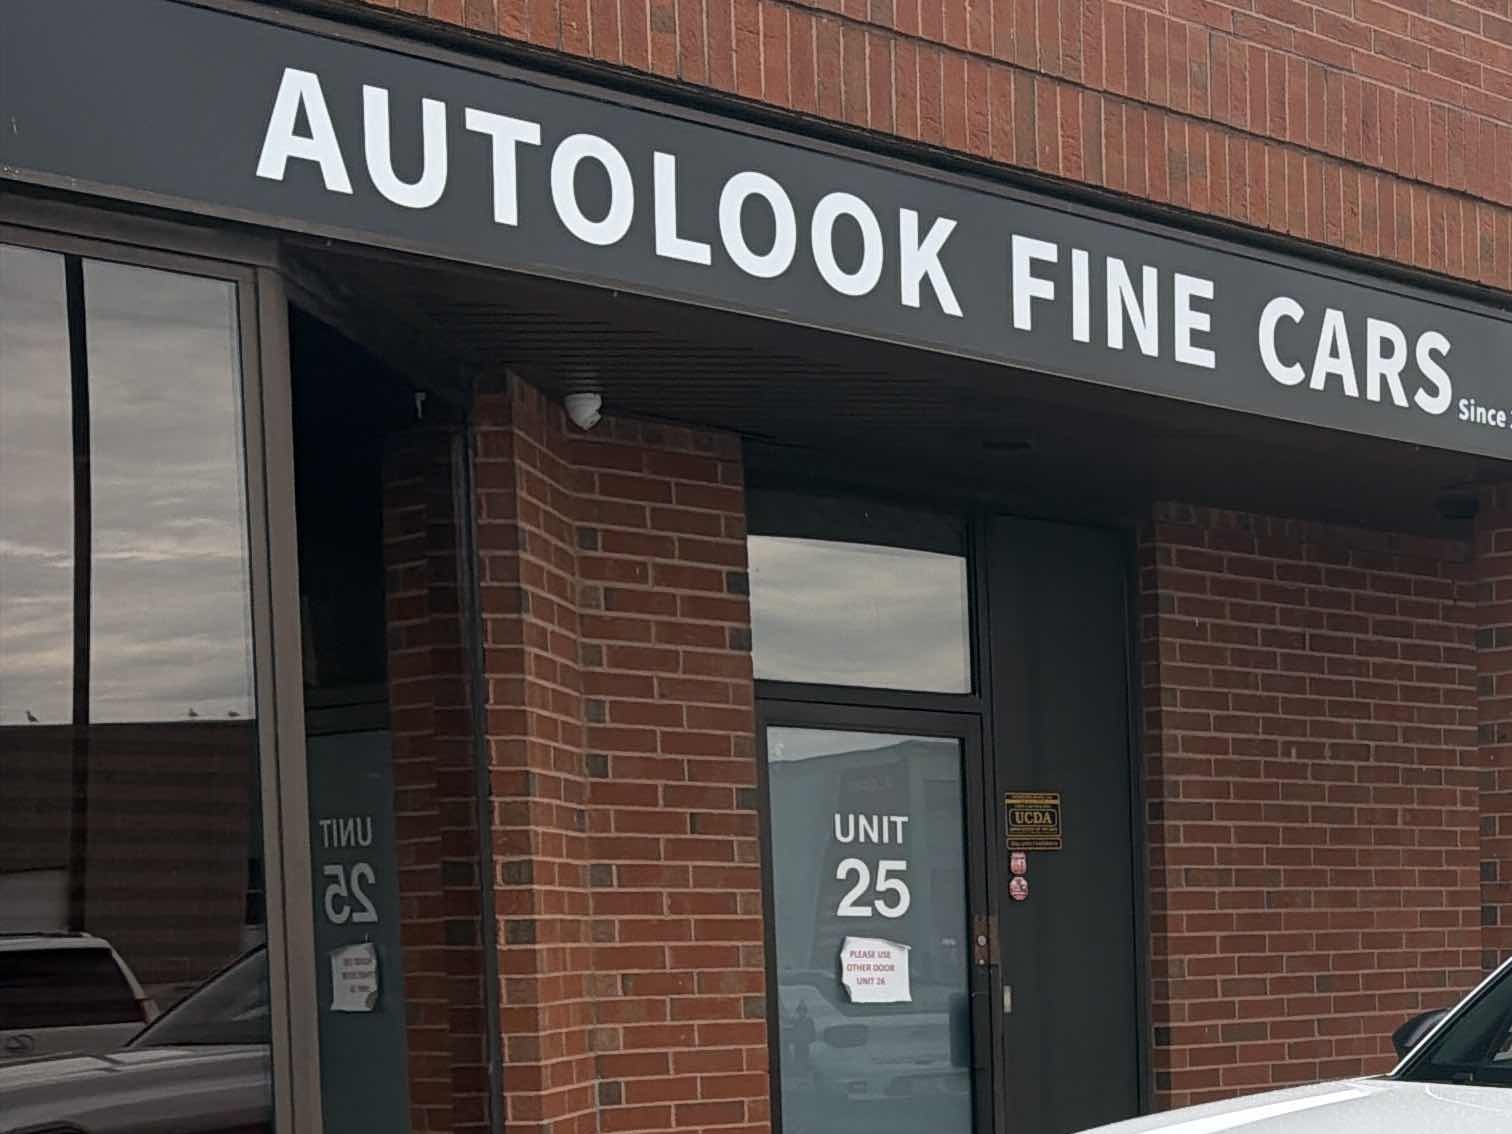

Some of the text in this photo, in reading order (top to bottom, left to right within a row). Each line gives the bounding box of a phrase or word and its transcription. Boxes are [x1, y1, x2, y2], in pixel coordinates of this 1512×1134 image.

[256, 67, 1453, 415] AUTOLOOK FINE CARS
[1458, 398, 1506, 429] Since
[834, 813, 909, 844] UNIT
[1014, 811, 1052, 824] UCDA
[836, 858, 911, 918] 25
[849, 950, 891, 959] PLEASE USE
[846, 963, 896, 972] OTHER DOOR
[856, 977, 875, 985] UNIT
